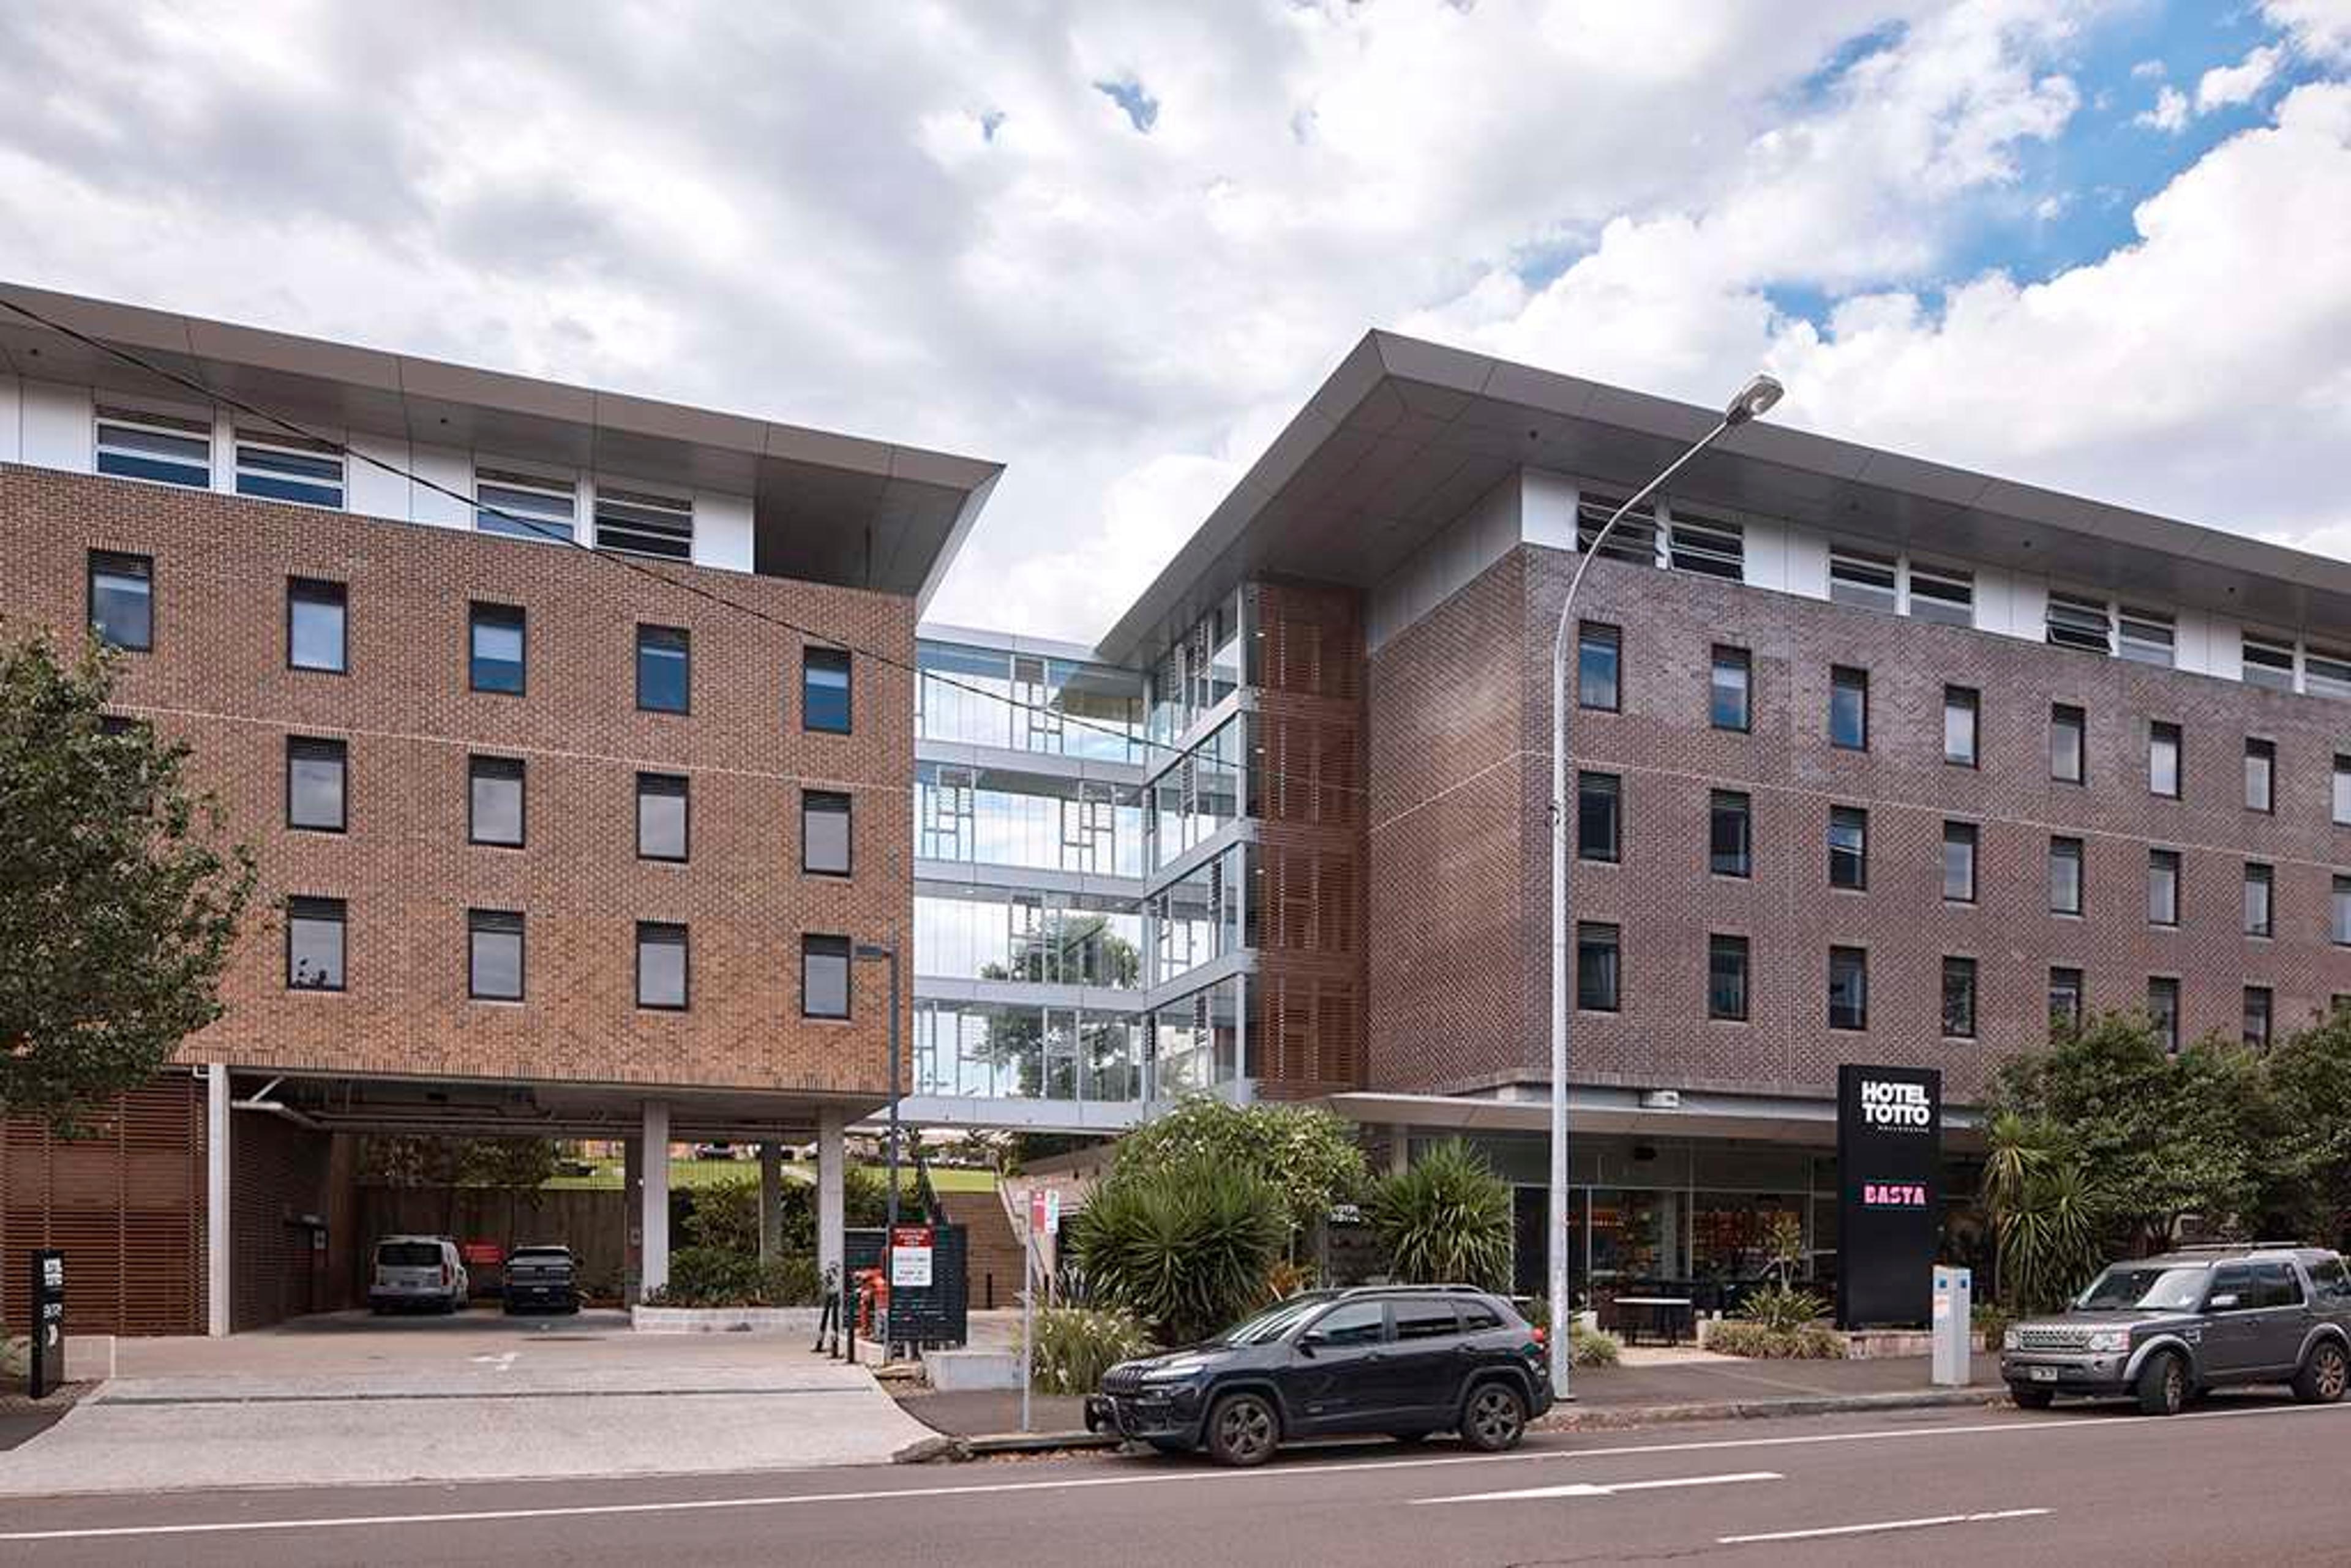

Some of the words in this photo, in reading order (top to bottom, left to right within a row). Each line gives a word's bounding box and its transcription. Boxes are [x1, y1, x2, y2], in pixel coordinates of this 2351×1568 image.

[1861, 1081, 1930, 1105] HOTEL
[1862, 1103, 1930, 1125] TOTTO
[1864, 1185, 1926, 1205] BASTA
